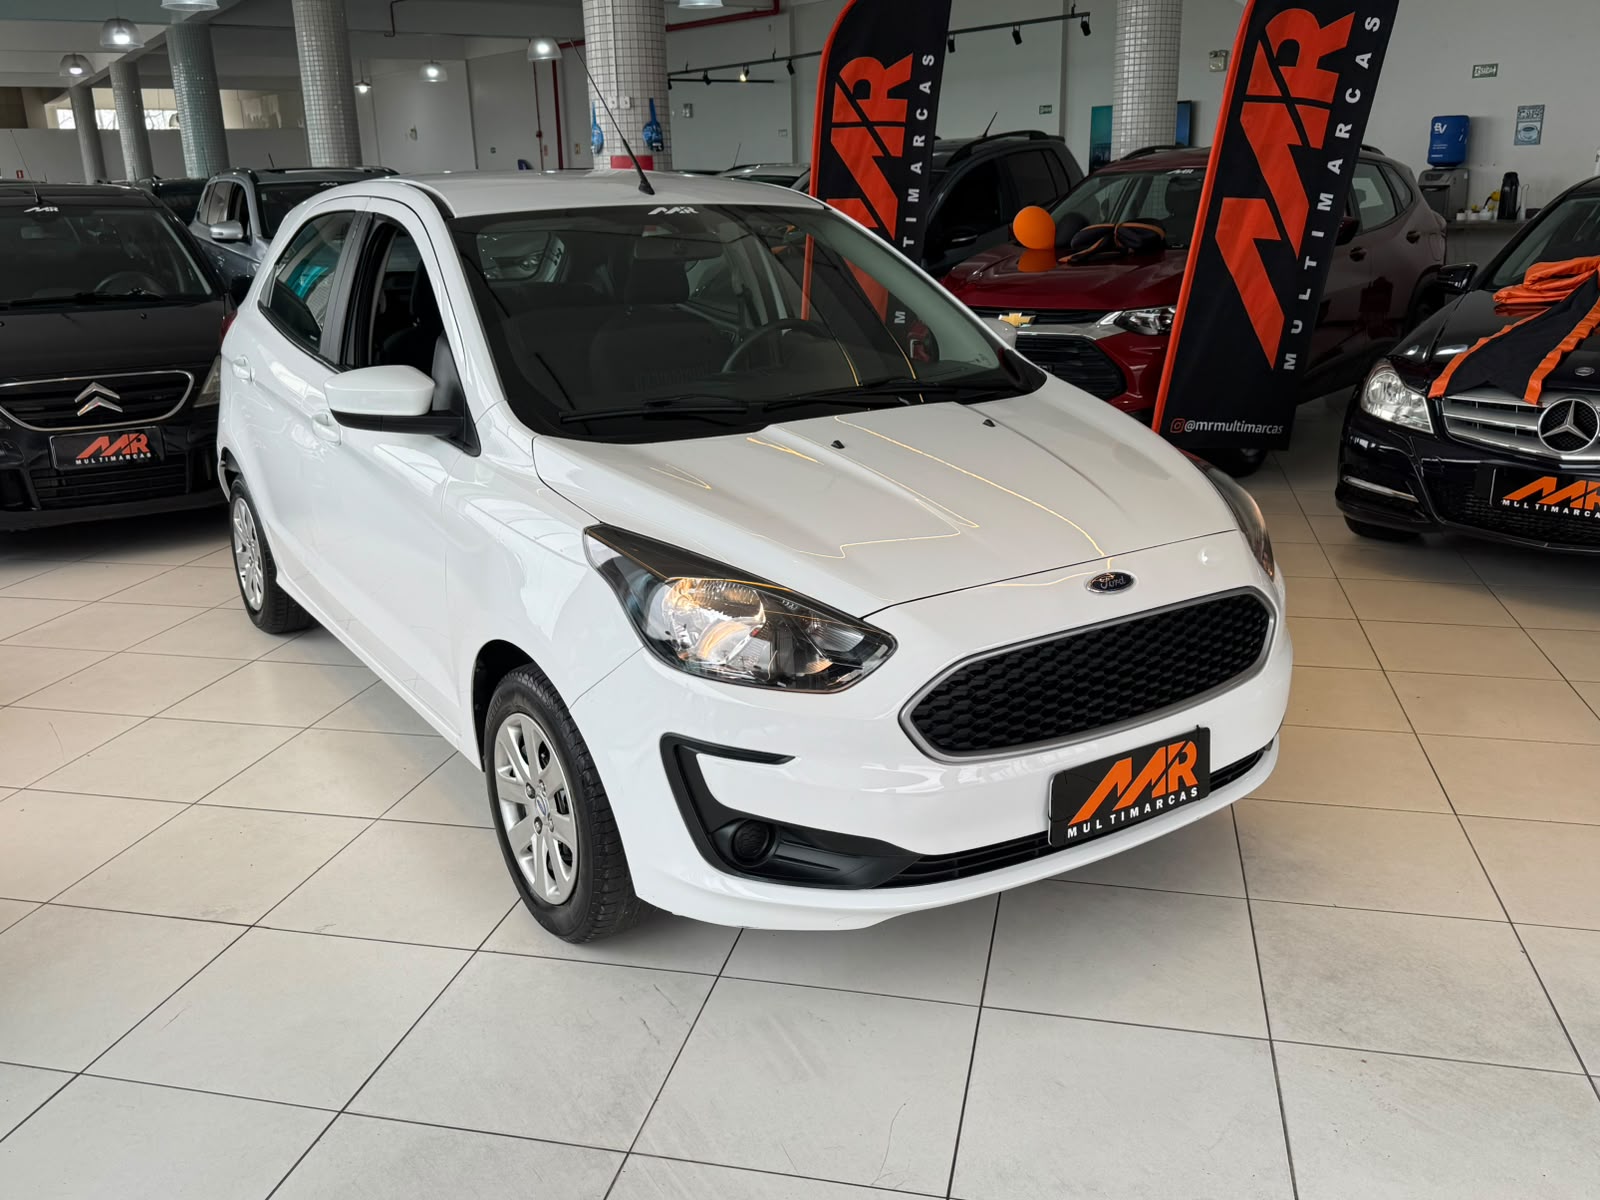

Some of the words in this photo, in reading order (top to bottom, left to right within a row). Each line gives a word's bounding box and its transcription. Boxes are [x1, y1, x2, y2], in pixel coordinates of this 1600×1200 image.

[894, 54, 935, 324] MTIMARCAS
[1283, 16, 1381, 371] MULTIMARCAS
[1184, 419, 1284, 435] @mrmultimarcas
[75, 452, 152, 465] MULTIMARCAS
[1501, 499, 1600, 518] MULTIMARCA
[1067, 787, 1199, 839] MULTIMARCAS
